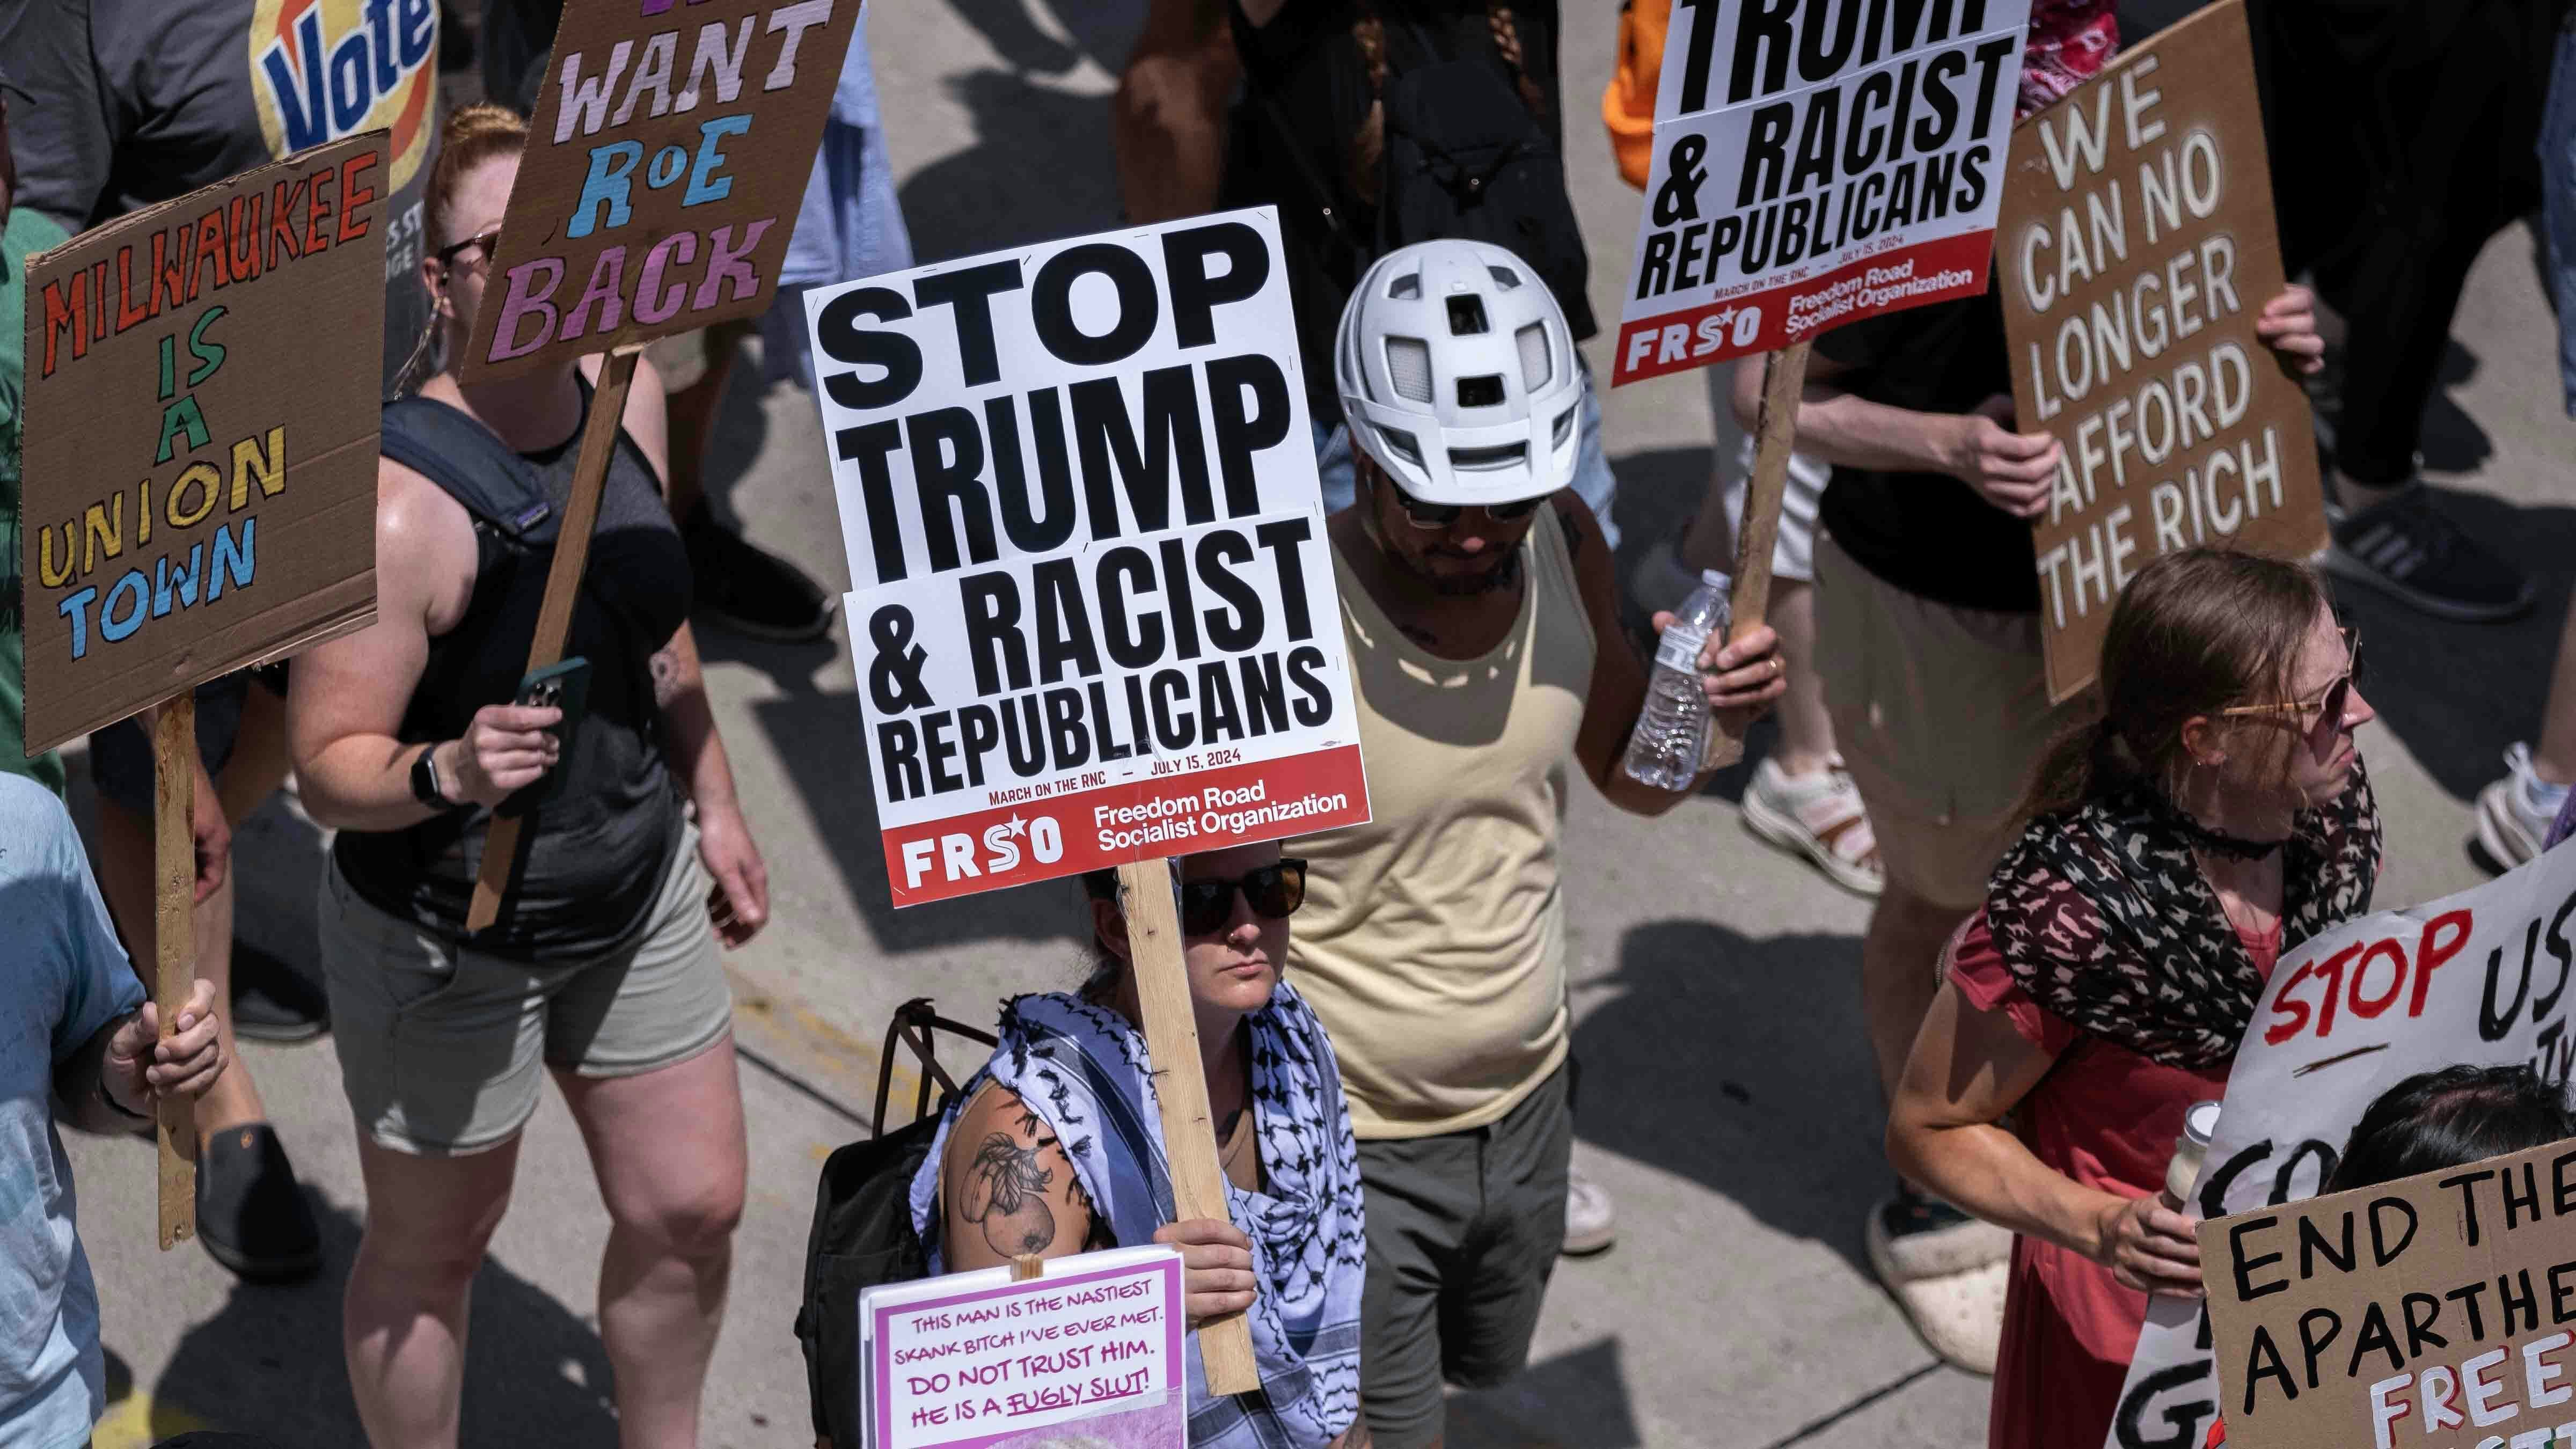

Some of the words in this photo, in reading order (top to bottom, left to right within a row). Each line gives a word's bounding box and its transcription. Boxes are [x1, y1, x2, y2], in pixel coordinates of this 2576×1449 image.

[260, 0, 434, 151] Vote
[553, 0, 835, 145] WANT
[1679, 0, 1987, 115] TRU
[2039, 54, 2167, 192] WE
[1652, 134, 1708, 228] &
[1737, 35, 2016, 209] RACIST
[41, 151, 378, 380] MILWAUKEE
[485, 216, 777, 364] BACK
[1636, 145, 1991, 301] REPUBLICANS
[1714, 282, 1750, 301] MARCH
[1751, 278, 1766, 293] ON
[1768, 273, 1789, 288] THE
[1789, 266, 1810, 282] RNC
[1839, 248, 1862, 265] JULY
[1879, 235, 1905, 251] 2024
[1789, 275, 1863, 316] Freedom
[1865, 258, 1915, 288] Road
[2022, 178, 2128, 313] CAN
[2139, 131, 2221, 244] NO
[157, 304, 230, 402] IS
[817, 221, 1270, 410] STOP
[1625, 306, 1762, 372] FRSO
[1785, 295, 1856, 334] Socialist
[1857, 268, 1973, 308] Organization
[2029, 235, 2242, 421] LONGER
[153, 393, 211, 466] A
[835, 353, 1291, 585] TRUMP
[2051, 341, 2252, 526] AFFORD
[39, 424, 287, 589] UNION
[2037, 503, 2138, 629] THE
[2150, 426, 2283, 554] RICH
[58, 515, 258, 663] TOWN
[868, 603, 936, 716] &
[959, 516, 1312, 697] RACIST
[877, 646, 1333, 803] REPUBLICANS
[988, 785, 1031, 806] MARCH
[1035, 782, 1052, 797] ON
[1055, 778, 1078, 793] THE
[1081, 771, 1107, 788] RNC
[1151, 759, 1182, 777] JULY
[1185, 755, 1204, 770] 15,
[1208, 748, 1242, 767] 2024
[902, 815, 1063, 889] FRSO
[1094, 794, 1200, 829] Freedom
[1204, 779, 1267, 815] Road
[1098, 818, 1198, 852] Socialist
[1201, 793, 1348, 835] Organization
[2265, 908, 2473, 1046] STOP
[2229, 1196, 2418, 1302] END
[2439, 1152, 2576, 1247] THE
[895, 1343, 962, 1365] SKANK
[965, 1335, 1015, 1356] BITCH
[1020, 1326, 1060, 1344] I'VE
[1064, 1317, 1116, 1339] EVER
[1120, 1305, 1164, 1328] MET.
[907, 1372, 950, 1395] DO
[958, 1359, 1013, 1386] NOT
[1016, 1345, 1094, 1378] TRUST
[1101, 1338, 1155, 1364] HIM.
[912, 1308, 952, 1334] THIS
[956, 1305, 1000, 1327] MAN
[1006, 1300, 1022, 1318] IS
[1024, 1297, 1063, 1315] THE
[1067, 1279, 1153, 1307] NASTIEST
[911, 1407, 949, 1429] HE
[955, 1399, 977, 1419] IS
[982, 1397, 1002, 1417] A
[1007, 1382, 1083, 1415] FUGLY
[1090, 1366, 1150, 1397] SLUT!
[2369, 1329, 2576, 1449] FREE
